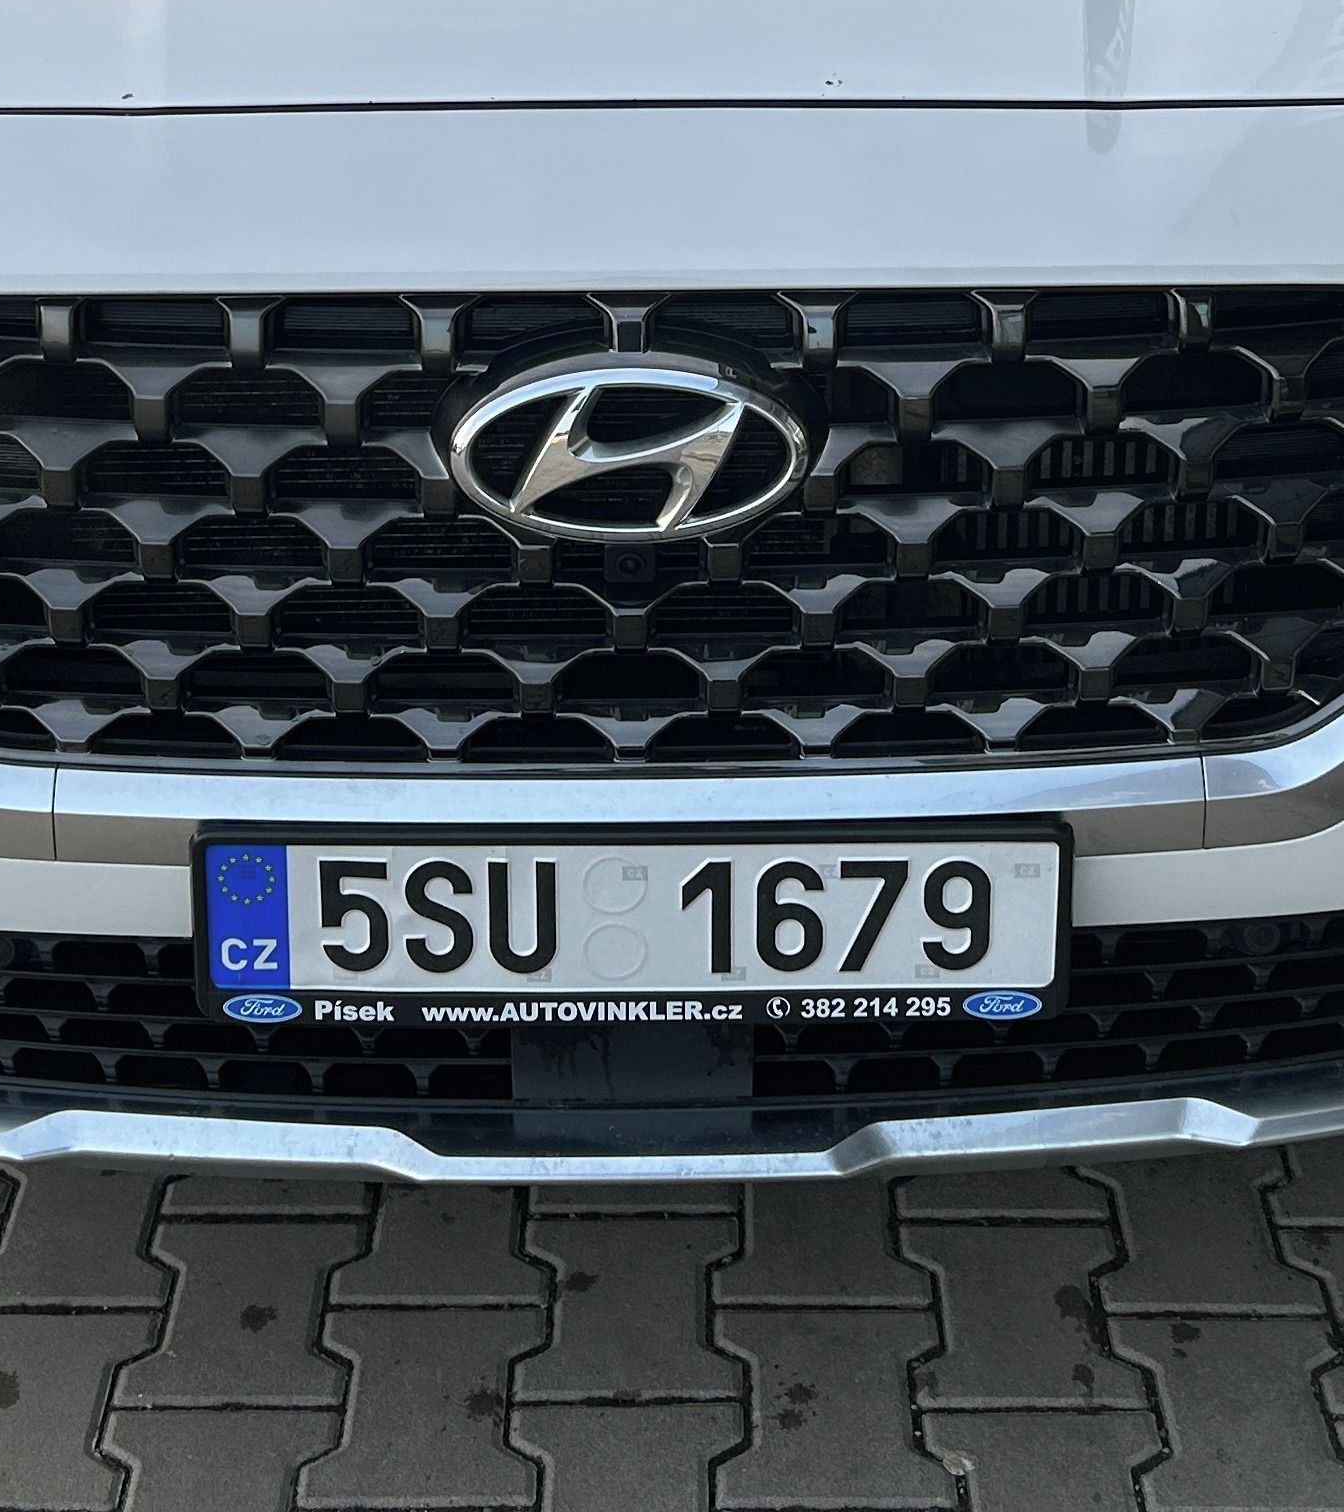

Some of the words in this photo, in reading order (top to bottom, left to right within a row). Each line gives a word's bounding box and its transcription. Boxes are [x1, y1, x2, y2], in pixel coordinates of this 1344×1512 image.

[319, 860, 557, 974] 5SU
[681, 860, 992, 973] 1679
[221, 938, 278, 971] CZ
[239, 1000, 285, 1016] Ford
[314, 999, 395, 1022] Písek
[421, 1000, 743, 1022] www.AUTOVINKLER.cz
[800, 997, 846, 1019] 382
[853, 996, 899, 1018] 214
[905, 996, 951, 1017] 295
[978, 995, 1026, 1014] Ford
